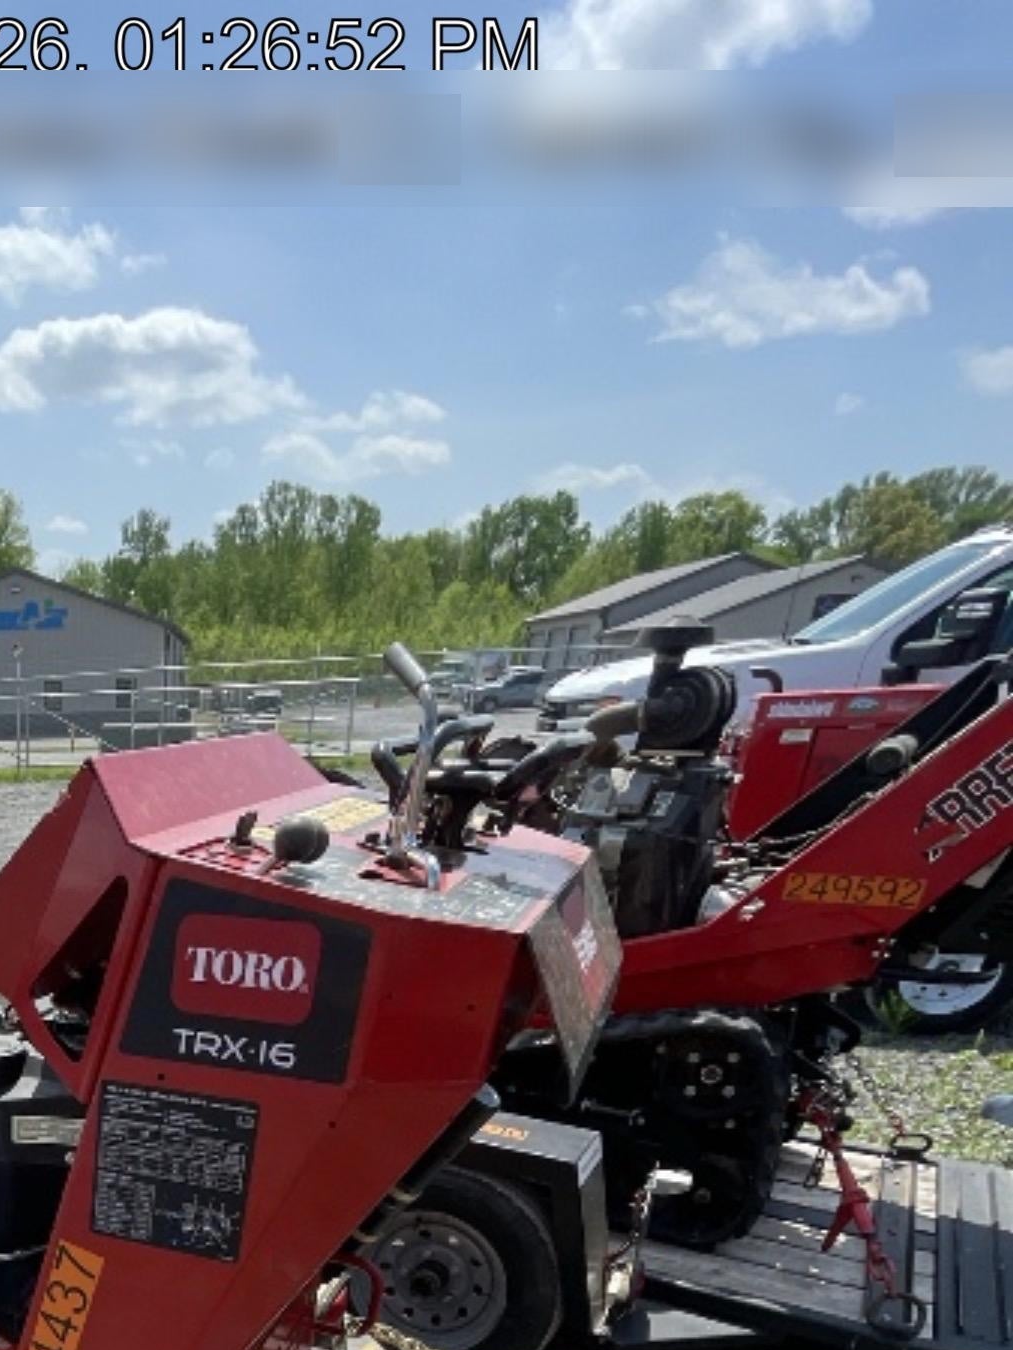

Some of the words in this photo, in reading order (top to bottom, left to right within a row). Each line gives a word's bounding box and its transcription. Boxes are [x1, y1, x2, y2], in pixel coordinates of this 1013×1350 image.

[785, 873, 922, 907] 249592
[187, 947, 306, 991] TORO
[173, 1028, 297, 1069] TRX-16
